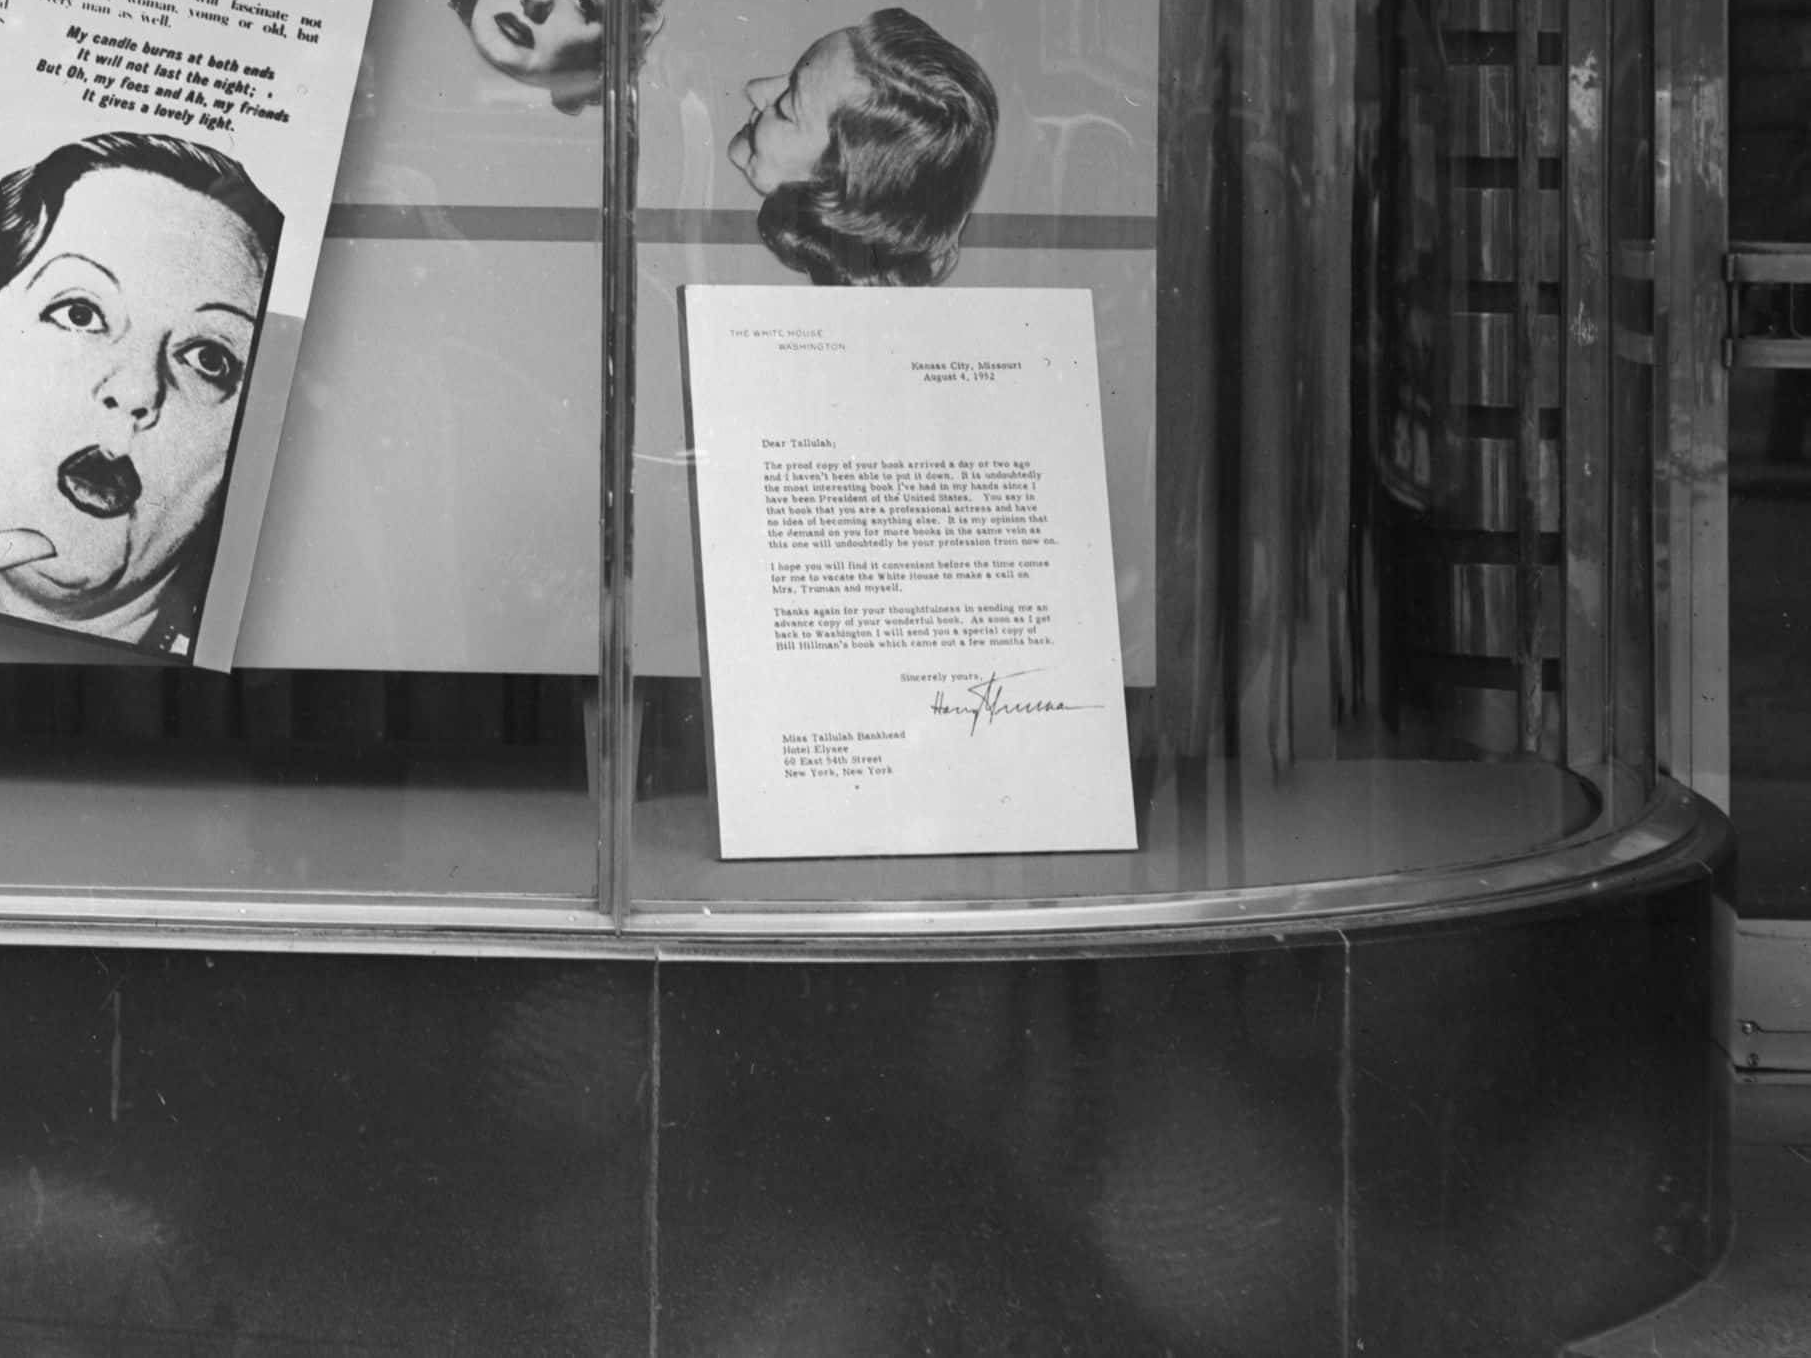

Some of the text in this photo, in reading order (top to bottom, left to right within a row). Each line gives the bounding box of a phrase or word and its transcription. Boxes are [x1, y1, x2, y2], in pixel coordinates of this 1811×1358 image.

[66, 25, 274, 79] My candle burns at both ends
[77, 47, 255, 97] It will not last the night;
[36, 58, 289, 122] But Oh, my foes and Ah, my friends
[82, 88, 234, 131] It gives a lovely light.
